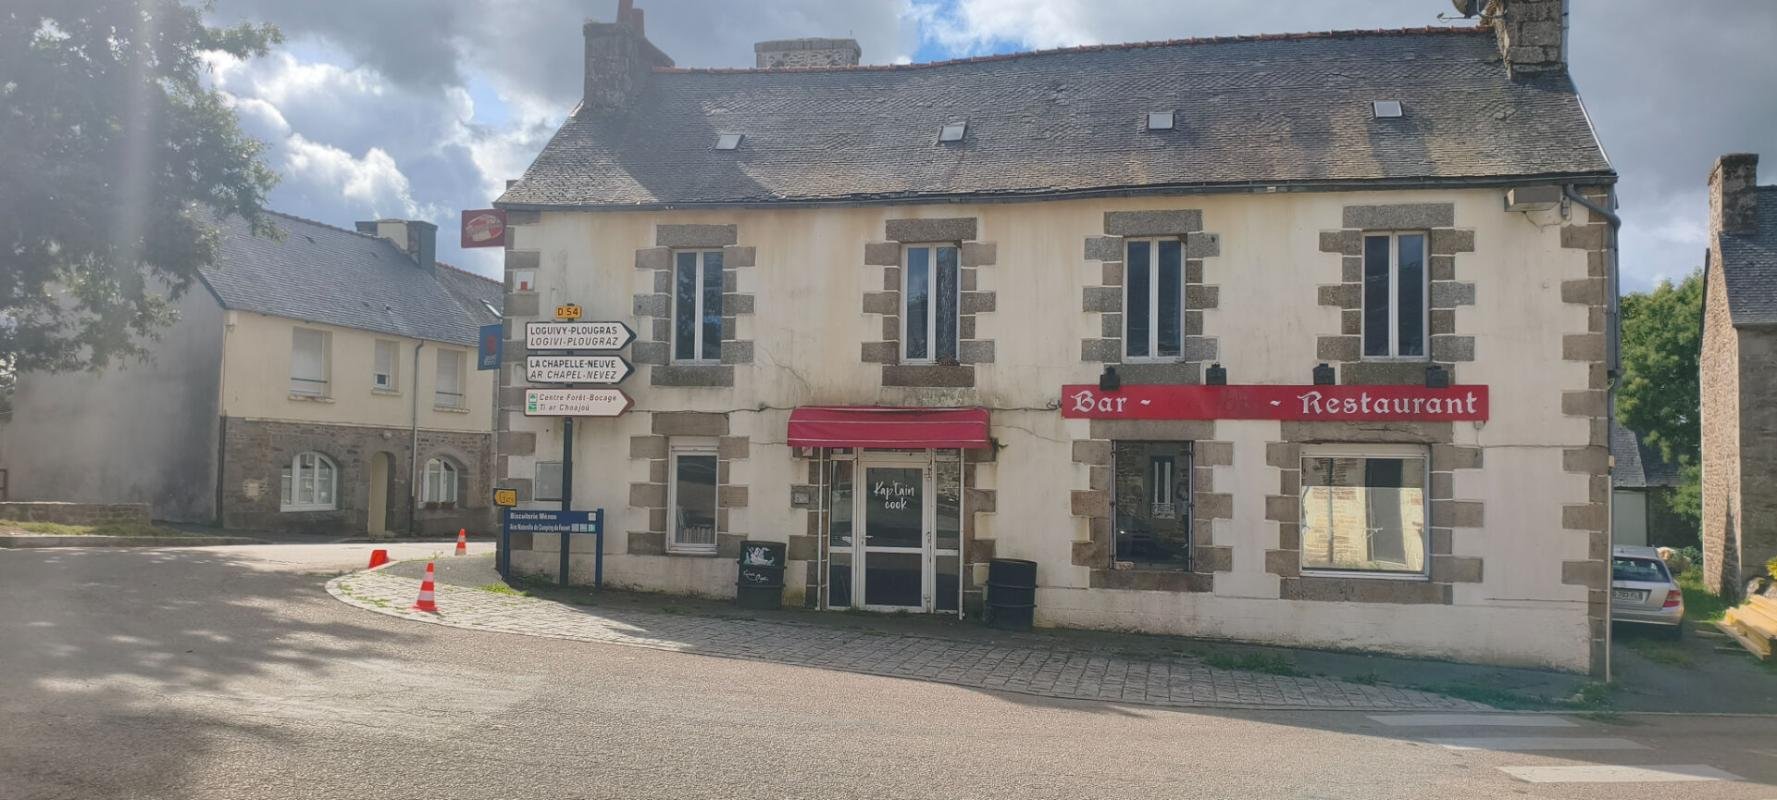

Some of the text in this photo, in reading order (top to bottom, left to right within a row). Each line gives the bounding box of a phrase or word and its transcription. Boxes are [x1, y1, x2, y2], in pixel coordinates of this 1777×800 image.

[558, 307, 579, 316] D 54
[530, 326, 617, 335] LOGUIVY-PLOUGRAS
[530, 337, 619, 346] LOGIVI-PLOUGRAZ
[530, 360, 616, 368] LA CHAPELLE-NEUVE
[530, 370, 617, 379] AR CHAPEL-NEVEZ
[539, 393, 564, 401] Centre
[1070, 390, 1128, 413] Bar
[1297, 391, 1478, 414] Restaurant
[884, 497, 907, 512] cook
